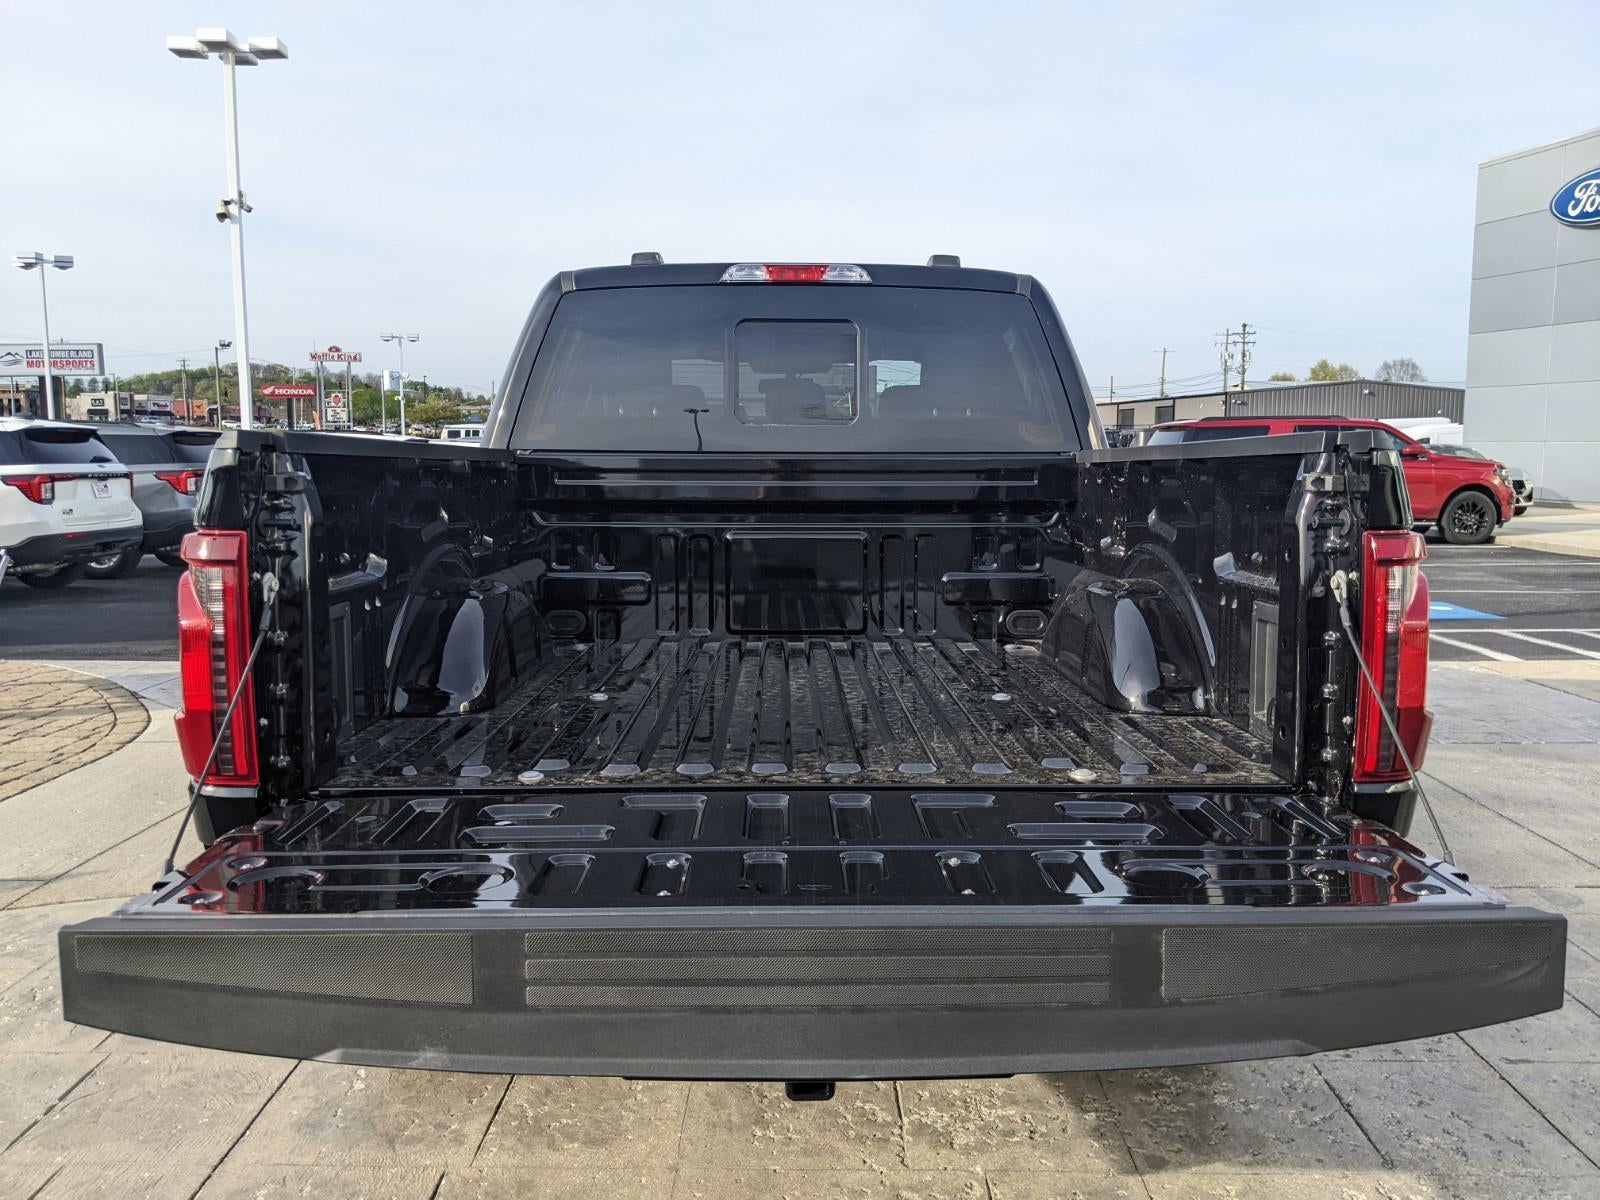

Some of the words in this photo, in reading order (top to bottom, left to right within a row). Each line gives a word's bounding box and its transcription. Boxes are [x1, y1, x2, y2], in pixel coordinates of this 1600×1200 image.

[1567, 179, 1600, 217] Fo
[27, 350, 44, 359] LAKE
[48, 350, 93, 359] UMBERLAND
[310, 353, 334, 361] Waffle
[337, 352, 358, 361] King
